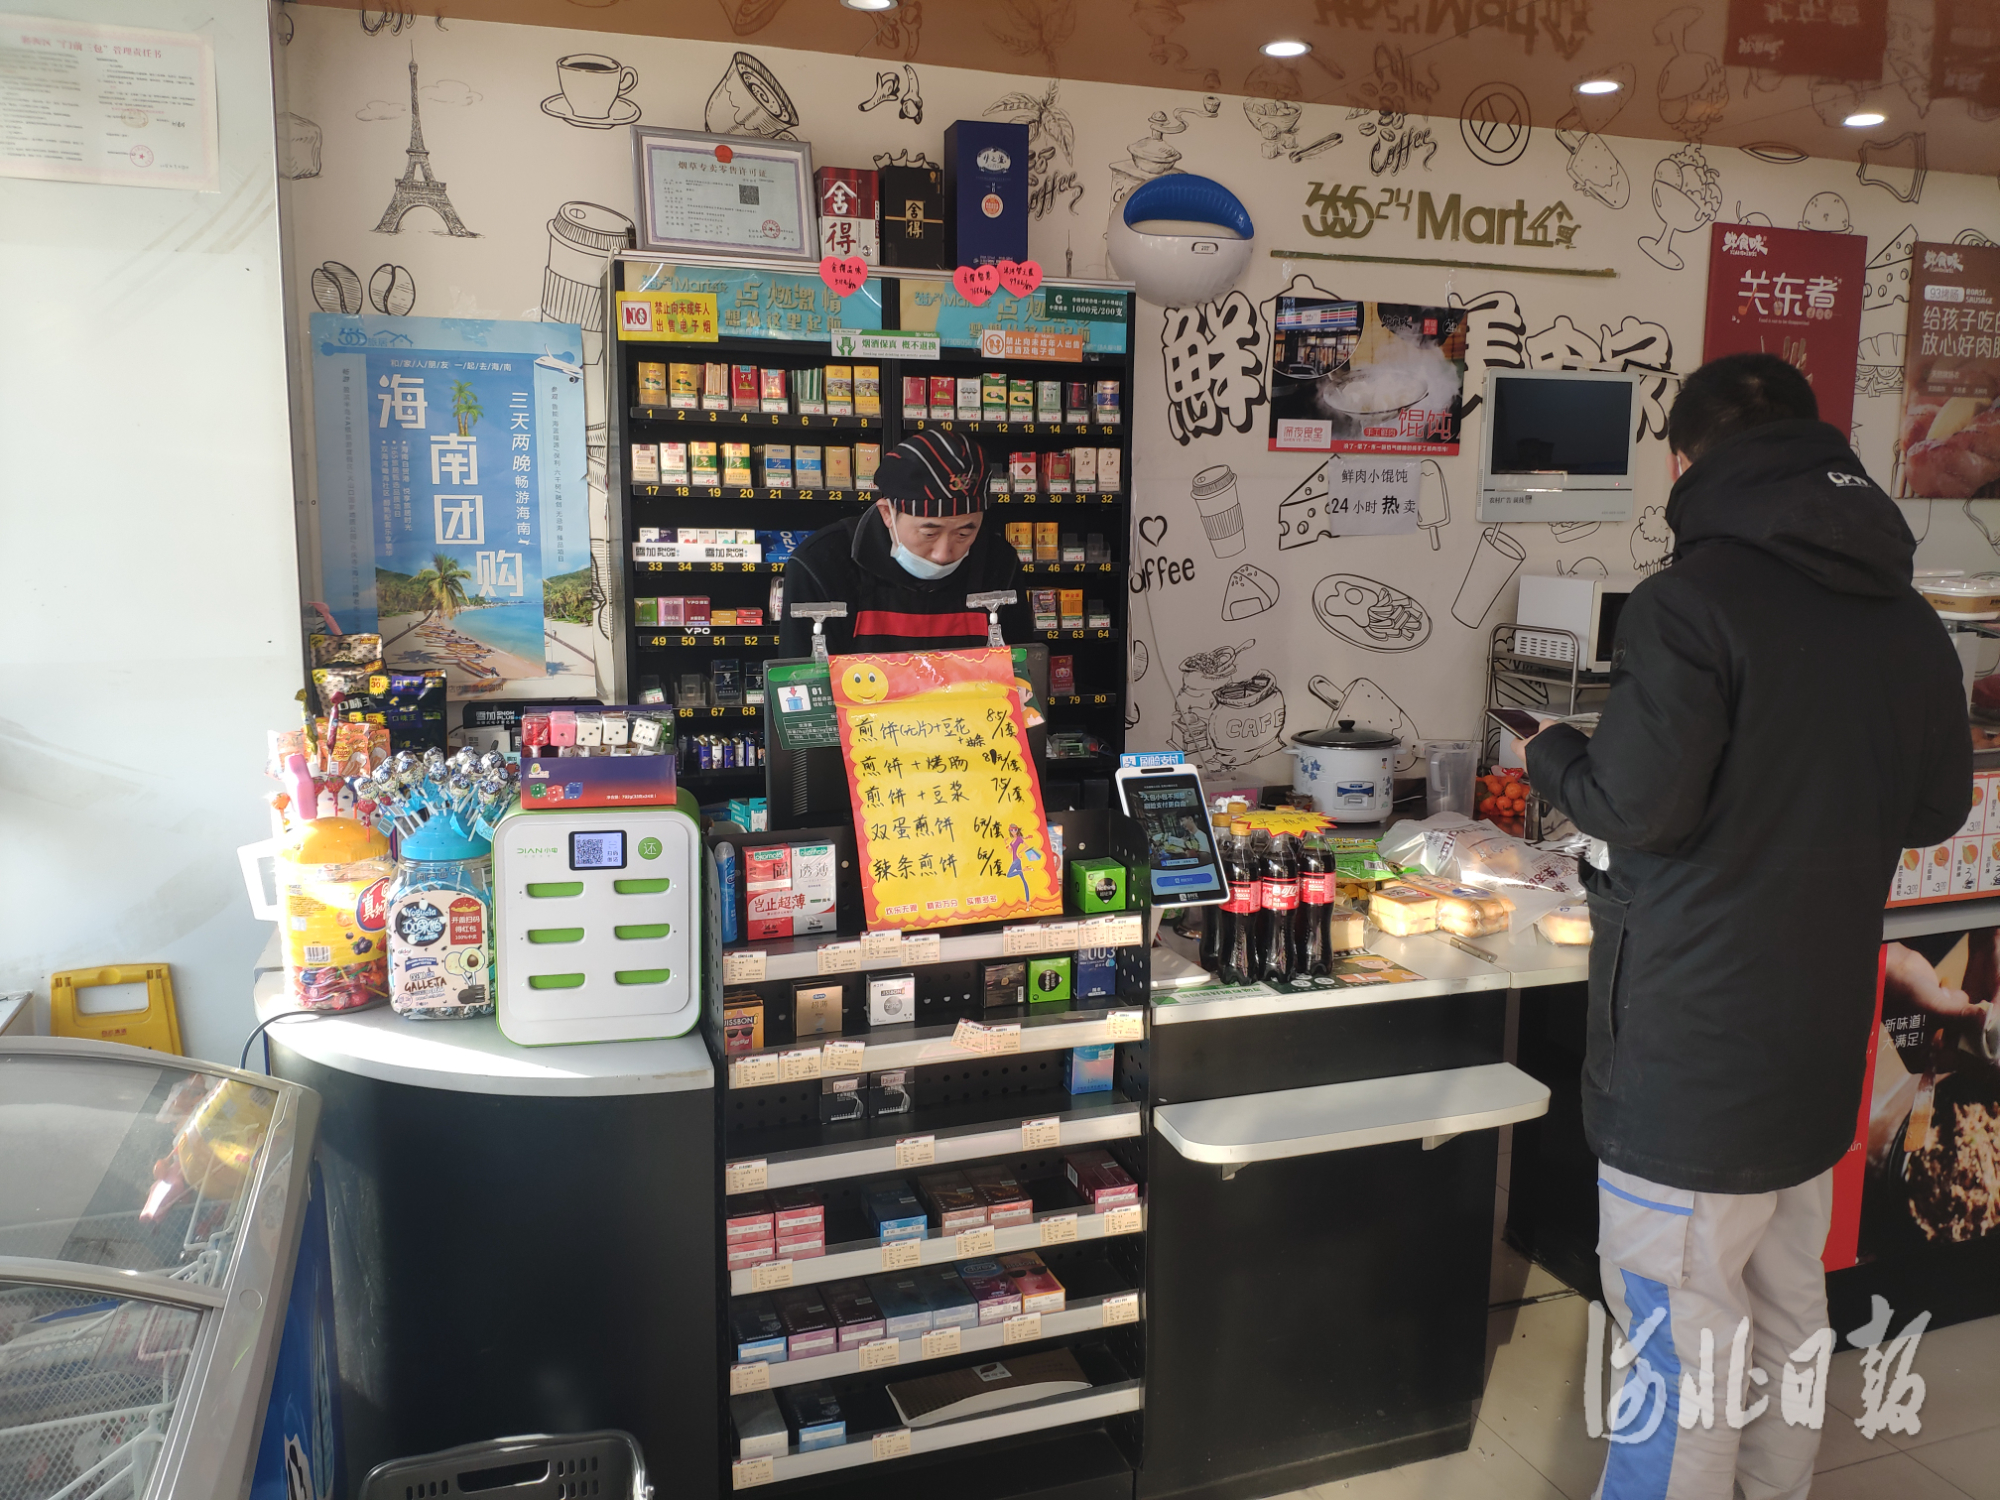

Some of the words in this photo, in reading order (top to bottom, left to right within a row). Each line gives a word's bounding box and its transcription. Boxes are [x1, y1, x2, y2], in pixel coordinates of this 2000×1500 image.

[1371, 126, 1438, 177] Coffee
[678, 161, 768, 177] 烟草专卖零售许可证
[1028, 171, 1083, 221] offee
[824, 180, 857, 255] 舍得
[907, 202, 923, 238] 舍得
[1302, 182, 1374, 238] 365
[1375, 188, 1413, 221] 24
[1418, 192, 1528, 245] Mart
[654, 300, 710, 316] 禁止向未成年人
[1072, 305, 1123, 317] 1000元/200支
[656, 318, 711, 334] 出售电子烟
[717, 309, 842, 332] 想从这里起航
[862, 338, 897, 350] 烟酒保真
[902, 339, 937, 351] 概不退换
[1005, 337, 1081, 349] 禁止向未成年人出售
[647, 410, 653, 419] 1
[678, 411, 685, 420] 2
[710, 412, 717, 421] 3
[741, 414, 748, 423] 4
[772, 415, 778, 424] 5
[802, 416, 809, 425] 6
[832, 418, 838, 427] 7
[861, 419, 867, 427] 8
[1398, 408, 1452, 440] 馄饨
[917, 421, 924, 429] 9
[941, 422, 952, 430] 10
[969, 422, 979, 431] 11
[997, 423, 1008, 432] 12
[1023, 424, 1034, 433] 13
[1050, 425, 1061, 433] 14
[1076, 425, 1086, 434] 15
[1102, 426, 1112, 434] 16
[509, 391, 532, 536] 三天两晚畅游海南
[1341, 468, 1408, 484] 鲜肉小馄饨
[646, 486, 659, 495] 17
[676, 487, 689, 496] 18
[708, 488, 721, 497] 19
[740, 489, 754, 498] 20
[770, 490, 782, 499] 21
[800, 490, 813, 500] 22
[829, 491, 842, 500] 23
[858, 492, 871, 501] 24
[998, 494, 1010, 503] 28
[1024, 494, 1036, 503] 29
[1050, 494, 1062, 503] 30
[1076, 494, 1086, 503] 31
[1101, 494, 1113, 503] 32
[1332, 497, 1349, 513] 24
[1353, 499, 1378, 514] 小时
[1381, 495, 1400, 515] 热
[1403, 500, 1416, 514] 卖
[635, 546, 656, 557] 雪加
[705, 547, 725, 557] 雪加
[648, 562, 662, 571] 33
[678, 562, 692, 571] 34
[710, 563, 724, 571] 35
[742, 563, 755, 571] 36
[771, 563, 784, 571] 37
[1022, 564, 1034, 572] 45
[1048, 564, 1060, 572] 46
[1074, 564, 1085, 572] 47
[1099, 563, 1111, 571] 48
[1129, 557, 1196, 594] offee
[684, 627, 711, 635] VPO
[1047, 631, 1058, 639] 62
[1097, 630, 1109, 638] 64
[652, 637, 666, 645] 49
[681, 637, 695, 645] 50
[713, 637, 726, 645] 51
[744, 637, 758, 645] 52
[1069, 696, 1080, 704] 79
[1095, 695, 1106, 703] 80
[476, 711, 496, 720] 雪加
[679, 708, 693, 717] 66
[711, 708, 725, 717] 67
[742, 707, 756, 716] 68
[1226, 708, 1287, 739] CAFE
[861, 757, 903, 778] 煎饼
[1139, 755, 1179, 767] 刷脸支付
[866, 786, 907, 809] 煎饼
[871, 817, 955, 842] 双蛋煎饼
[643, 842, 657, 855] 还
[874, 855, 958, 883] 辣条煎饼
[754, 894, 806, 913] 岂止超薄
[451, 916, 480, 924] 开盖扫码
[455, 925, 477, 933] 得红包
[404, 976, 448, 993] GALLETA
[724, 1016, 755, 1026] JISSBON
[1884, 1015, 1927, 1032] 新味道!
[965, 1263, 996, 1273] durex
